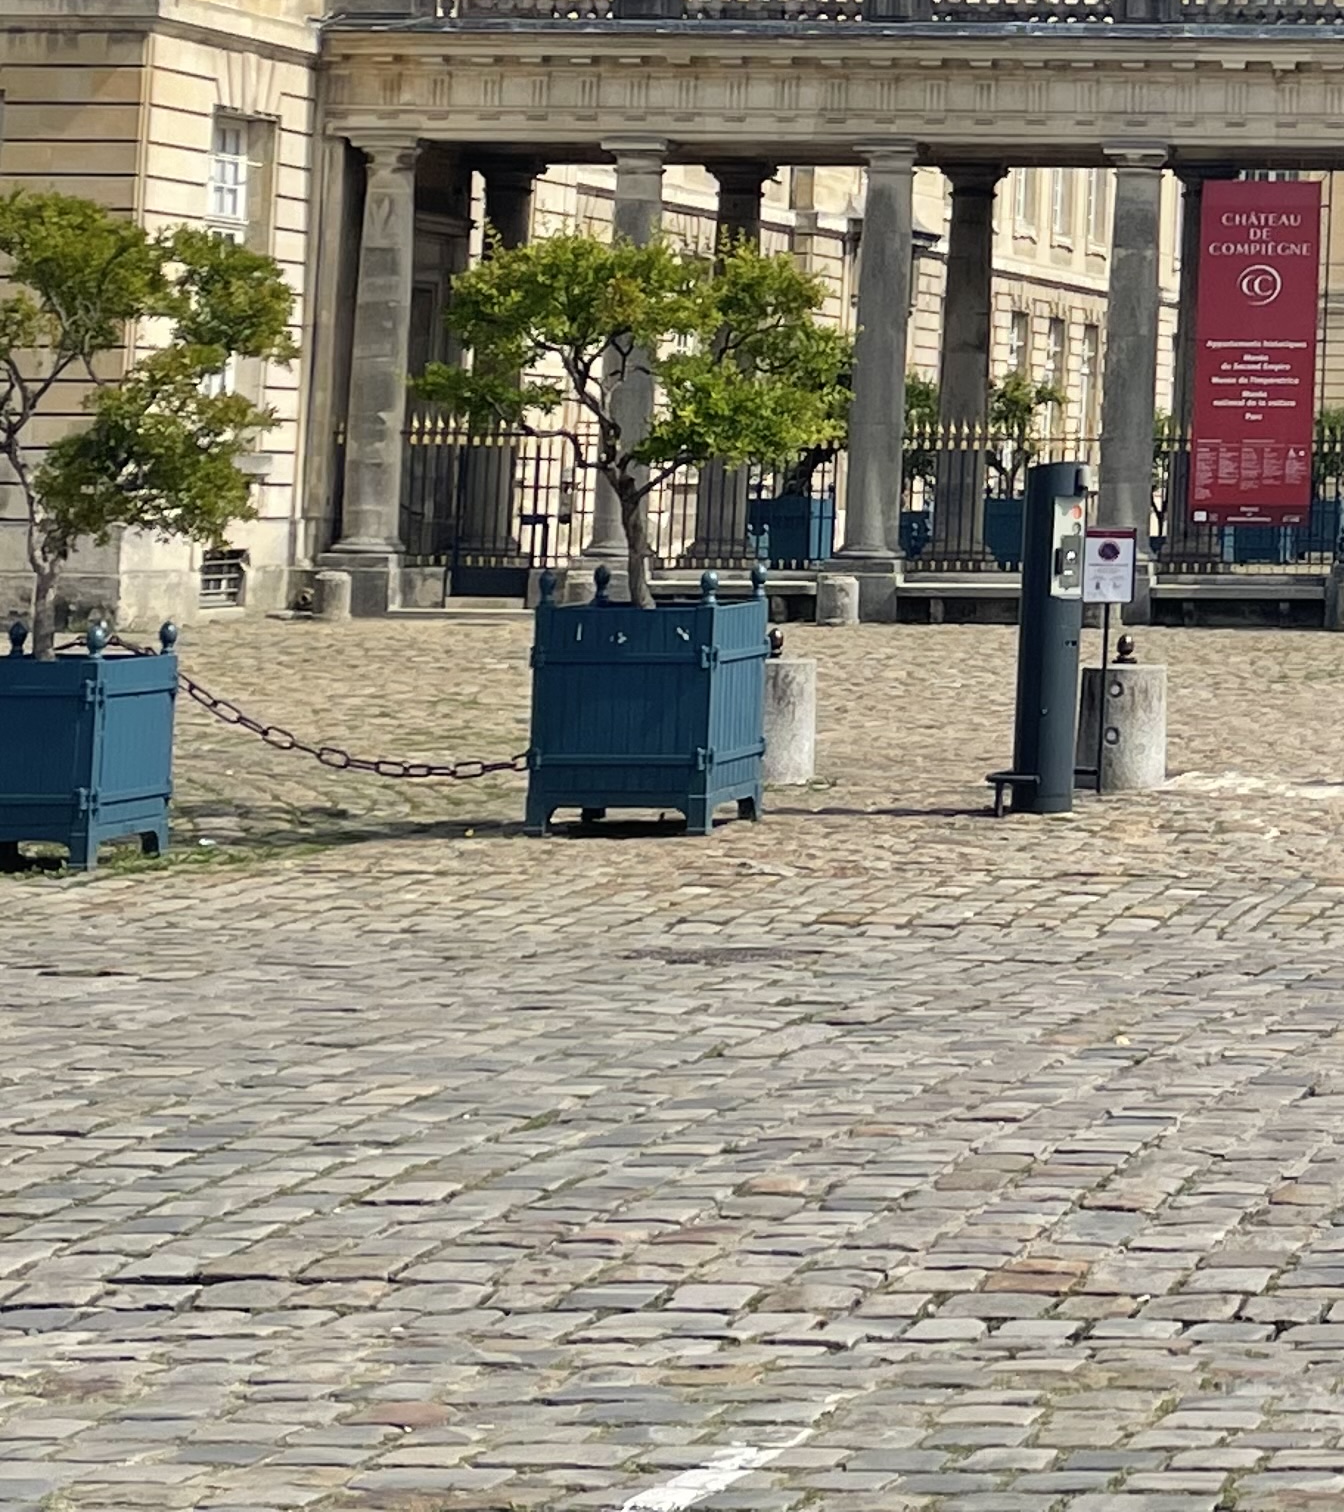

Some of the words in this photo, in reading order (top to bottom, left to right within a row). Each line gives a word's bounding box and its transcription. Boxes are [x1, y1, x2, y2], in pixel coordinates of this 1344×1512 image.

[1221, 211, 1302, 226] CHÂTEAU
[1249, 228, 1271, 240] DE
[1208, 242, 1311, 256] COMPIÈGNE
